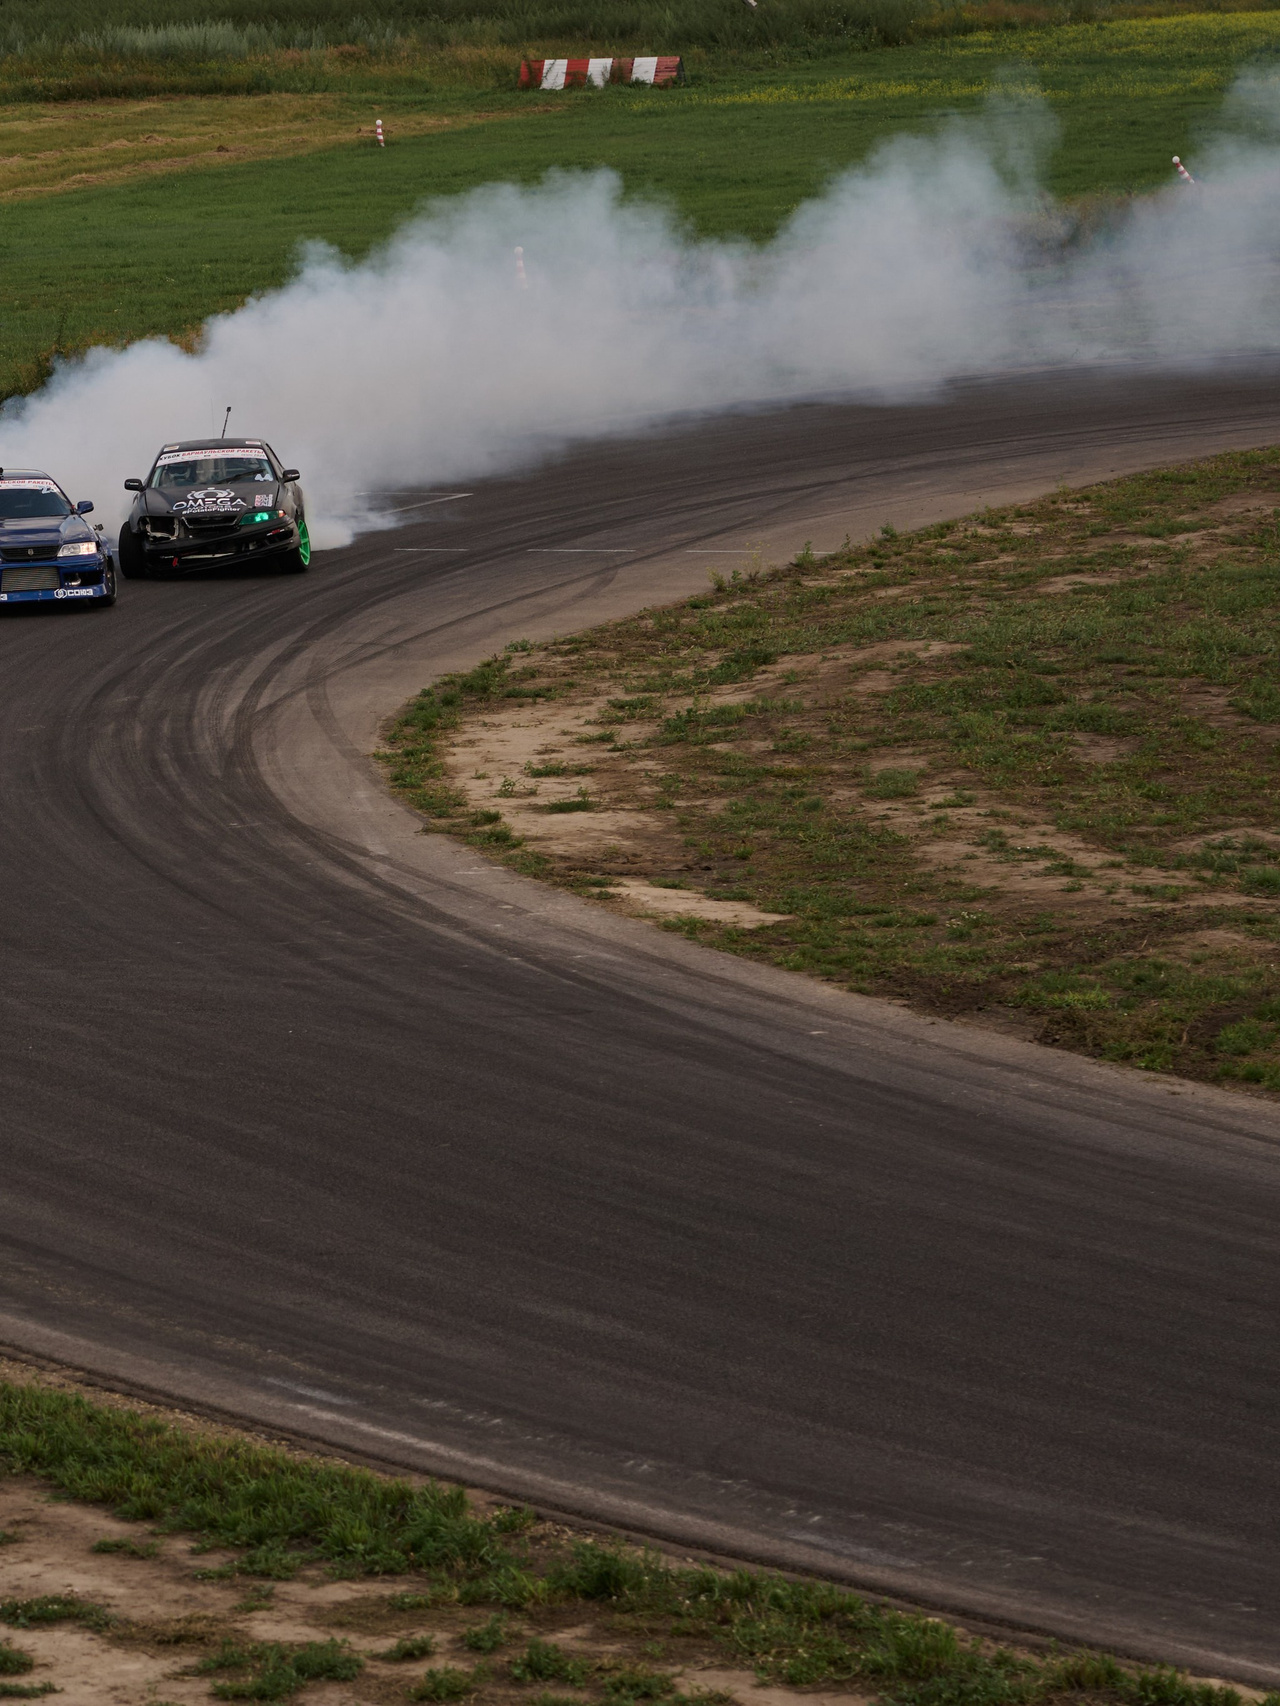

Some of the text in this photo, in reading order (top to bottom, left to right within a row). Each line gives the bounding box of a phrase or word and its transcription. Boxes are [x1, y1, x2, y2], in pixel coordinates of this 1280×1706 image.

[159, 453, 181, 461] КУБОК
[173, 498, 247, 510] OMEGA
[67, 588, 94, 596] СОЮЗ
